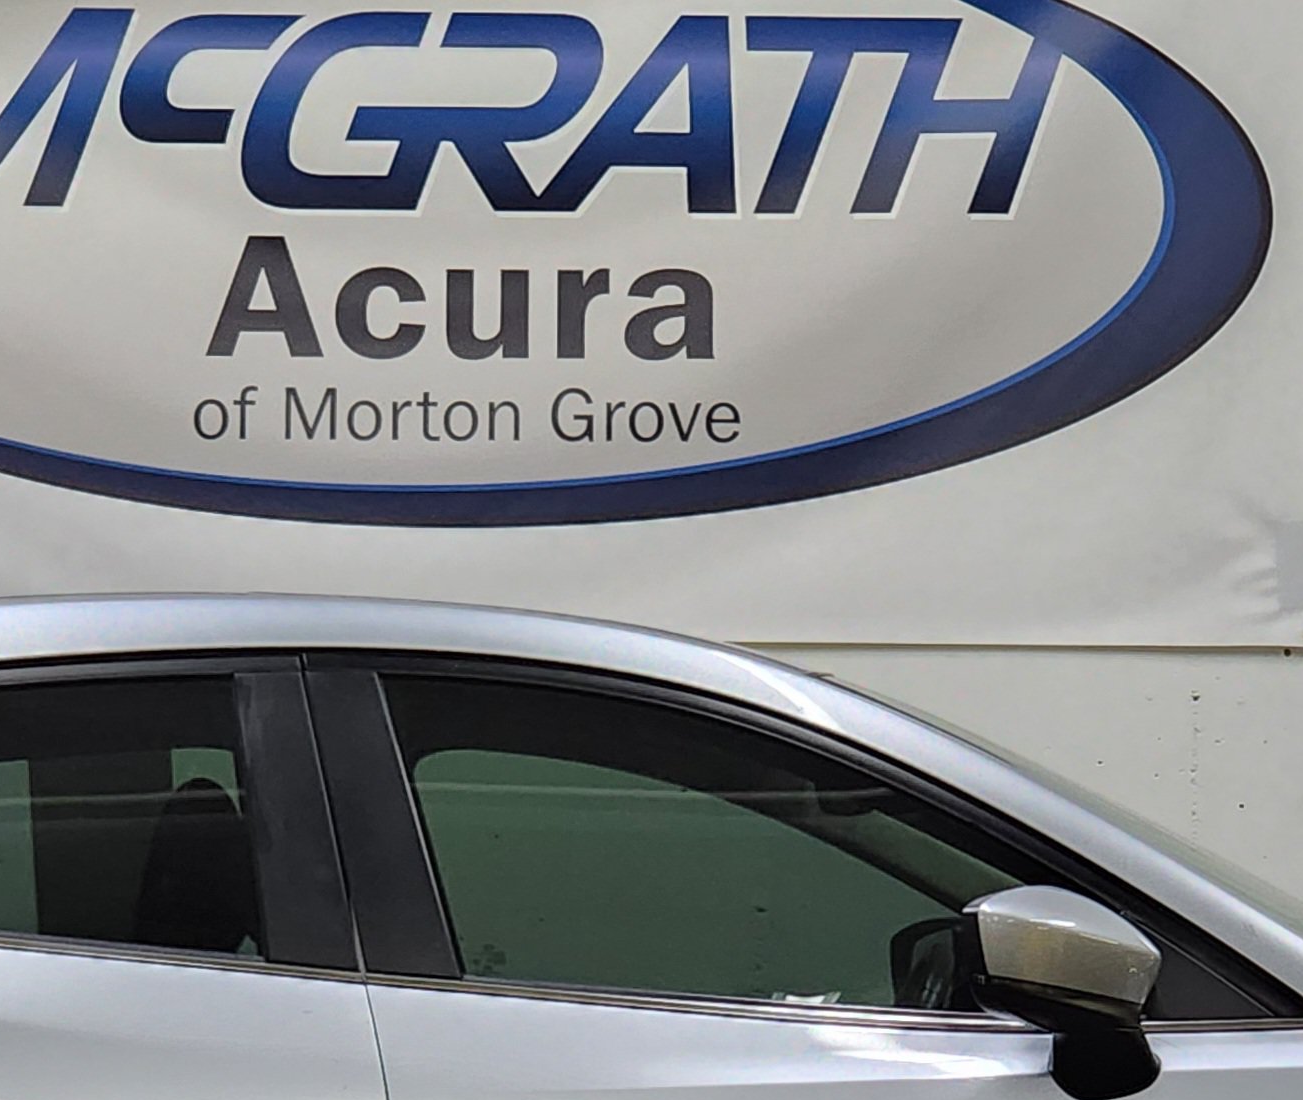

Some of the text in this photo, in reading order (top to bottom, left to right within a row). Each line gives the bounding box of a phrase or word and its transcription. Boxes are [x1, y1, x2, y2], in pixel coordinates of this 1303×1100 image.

[205, 235, 716, 361] Acura
[193, 385, 742, 444] of Morton Grove
